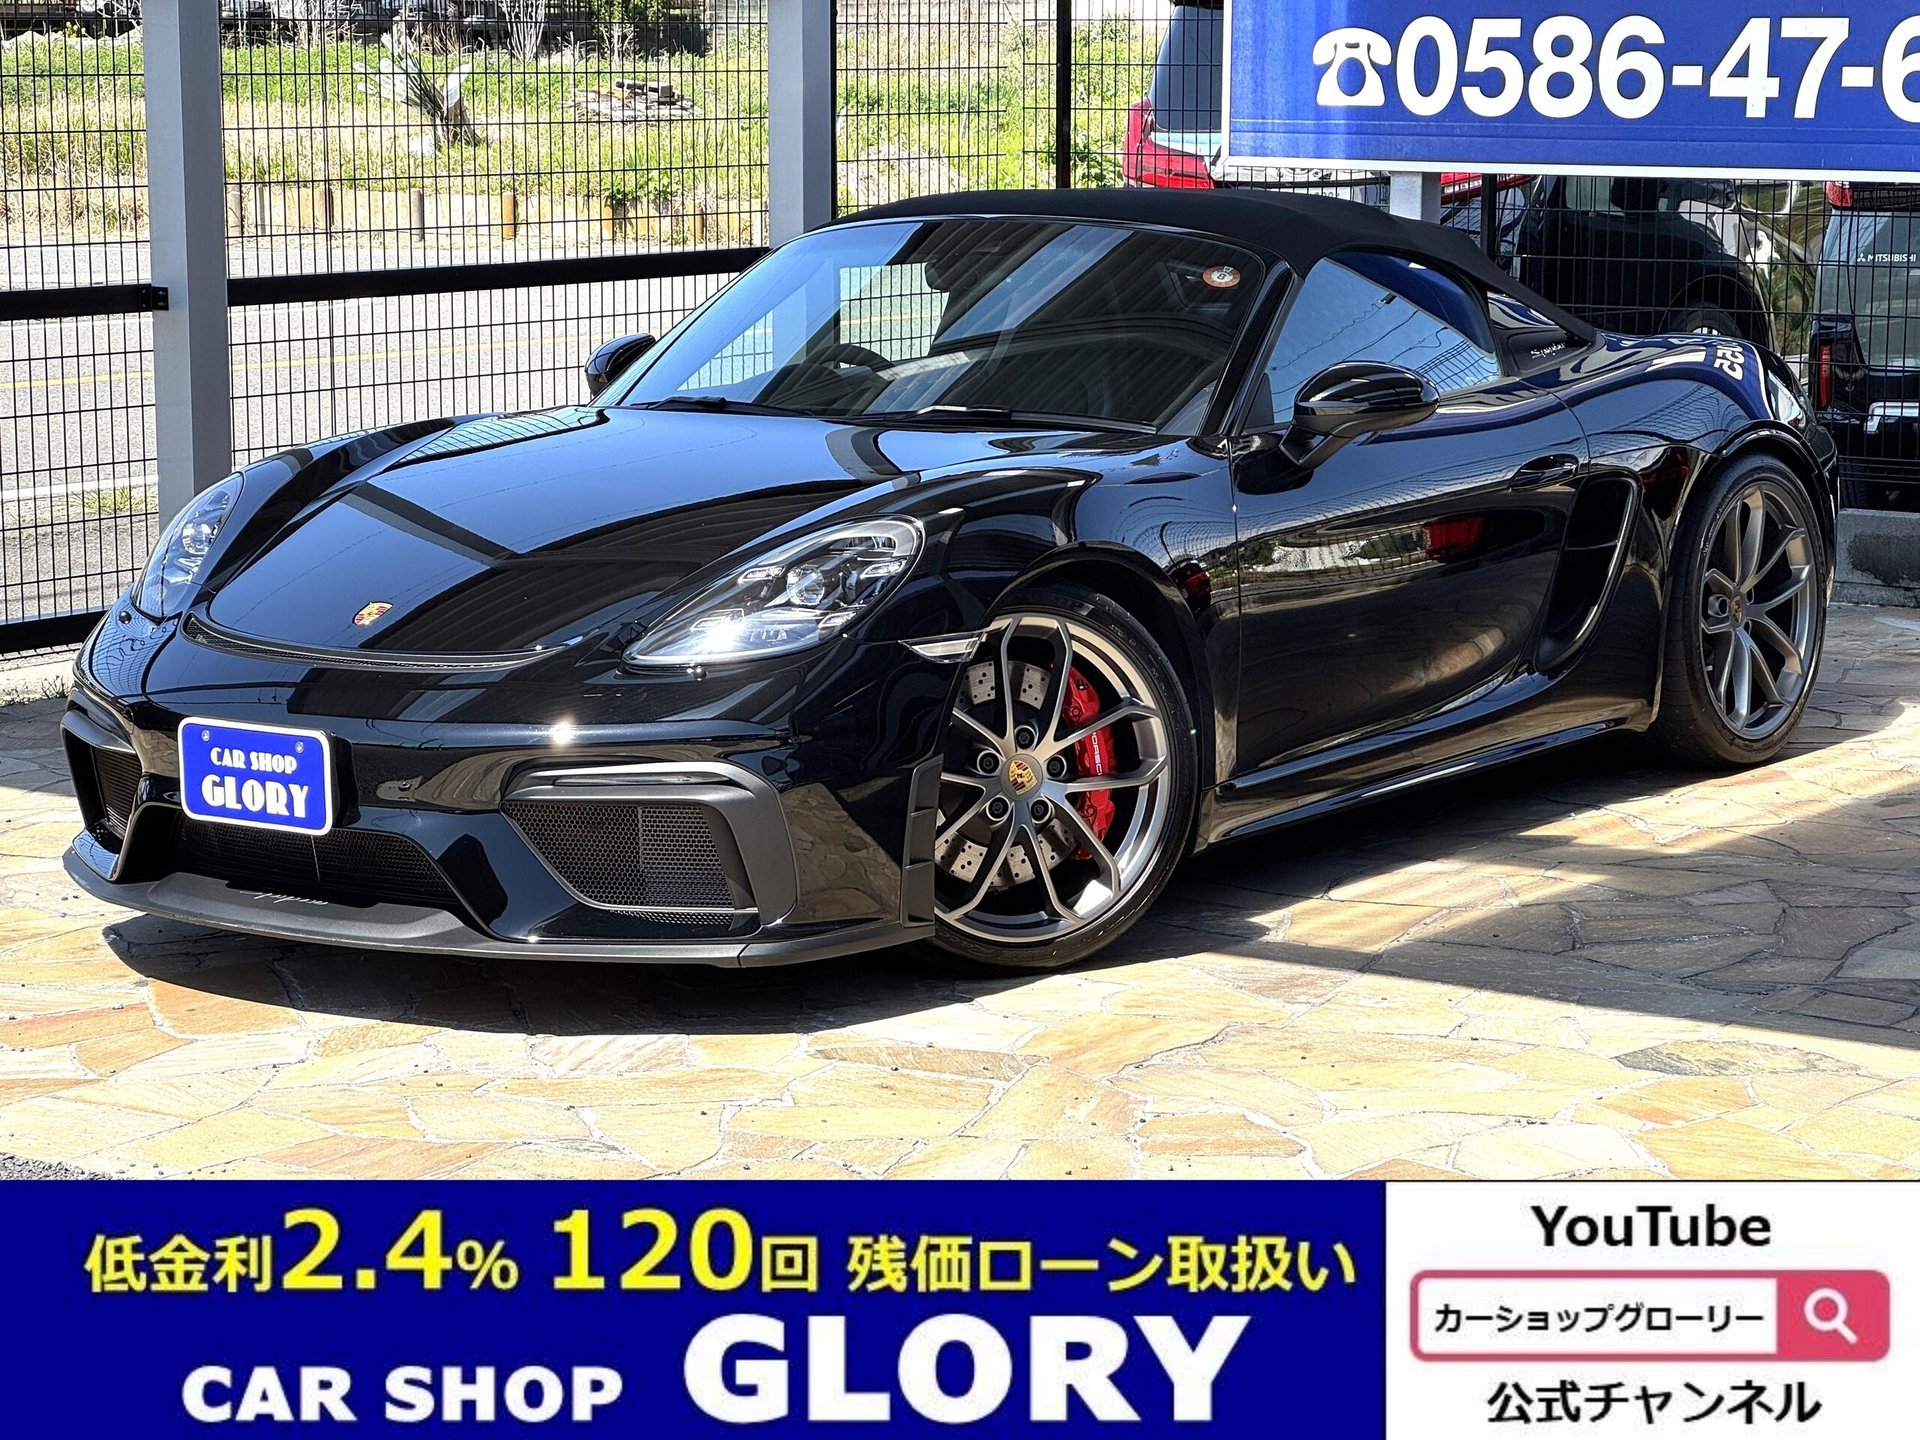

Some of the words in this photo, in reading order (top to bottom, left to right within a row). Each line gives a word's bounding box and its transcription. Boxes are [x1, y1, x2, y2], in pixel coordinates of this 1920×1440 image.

[1867, 253, 1917, 262] MITSUBISHI
[210, 747, 246, 769] CAR
[250, 751, 298, 775] SHOP
[201, 774, 310, 818] GLORY
